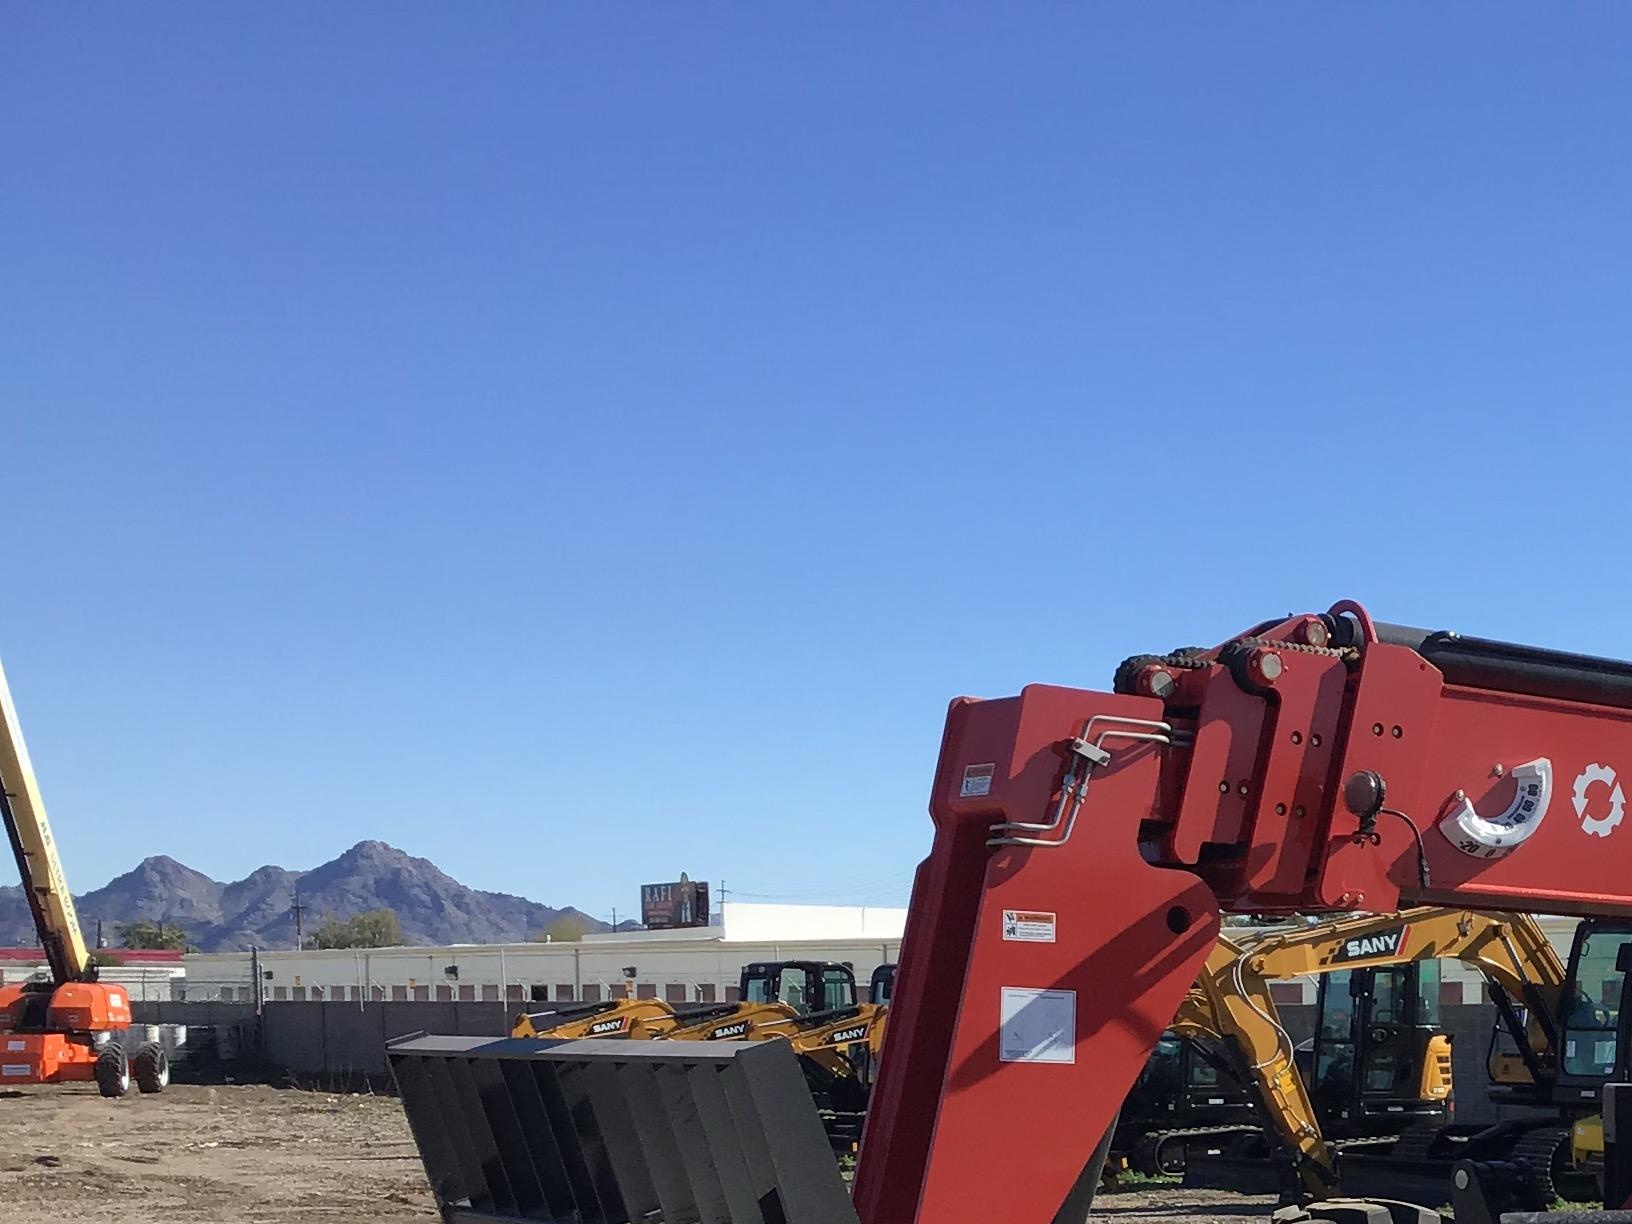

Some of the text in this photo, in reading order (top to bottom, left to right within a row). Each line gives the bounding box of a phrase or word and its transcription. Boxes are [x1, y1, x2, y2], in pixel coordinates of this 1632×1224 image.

[1459, 841, 1480, 854] -20
[1346, 934, 1398, 957] SANY
[592, 1020, 622, 1034] SANY
[714, 1024, 745, 1039] SANY
[833, 1027, 865, 1042] SANY
